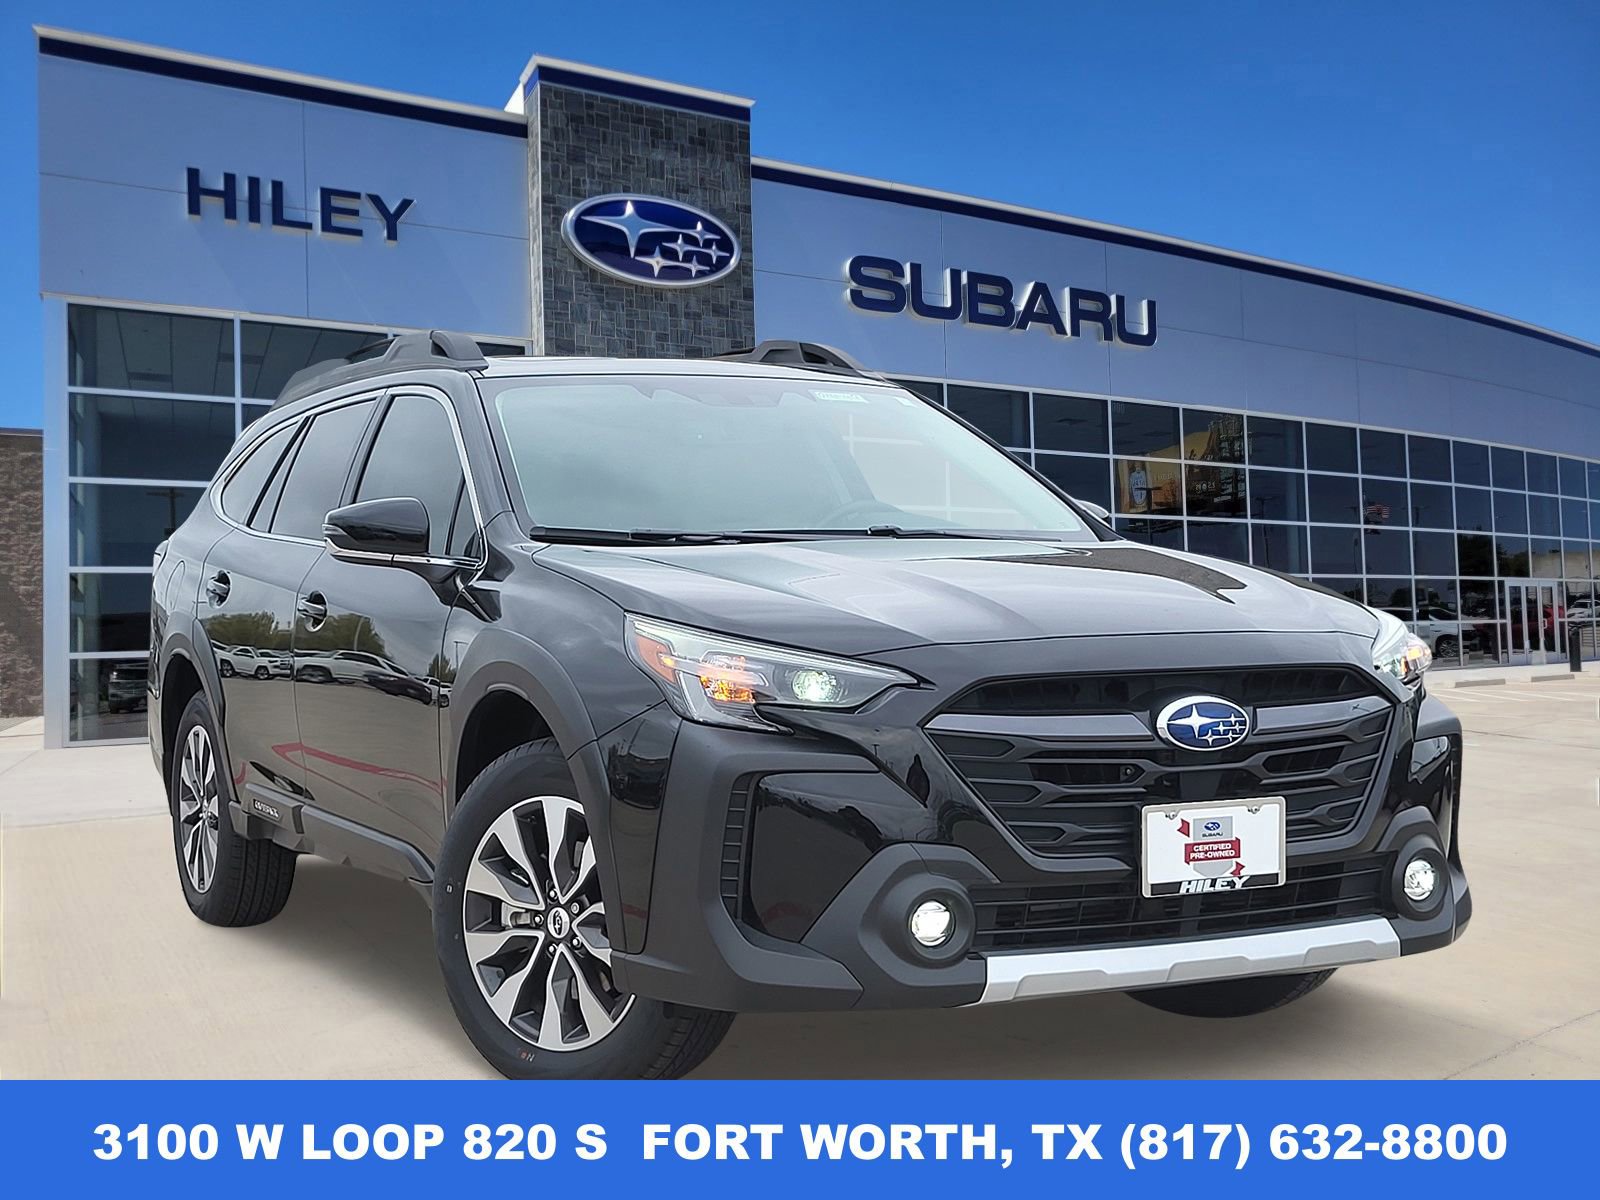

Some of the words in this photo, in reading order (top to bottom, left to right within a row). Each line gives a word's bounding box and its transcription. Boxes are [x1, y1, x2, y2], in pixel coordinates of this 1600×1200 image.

[187, 167, 416, 242] HILEY
[848, 255, 1158, 347] SUBARU
[1189, 850, 1236, 860] PRE-OWNED
[1193, 843, 1232, 852] CERTIFIED
[1179, 876, 1250, 894] HILEY
